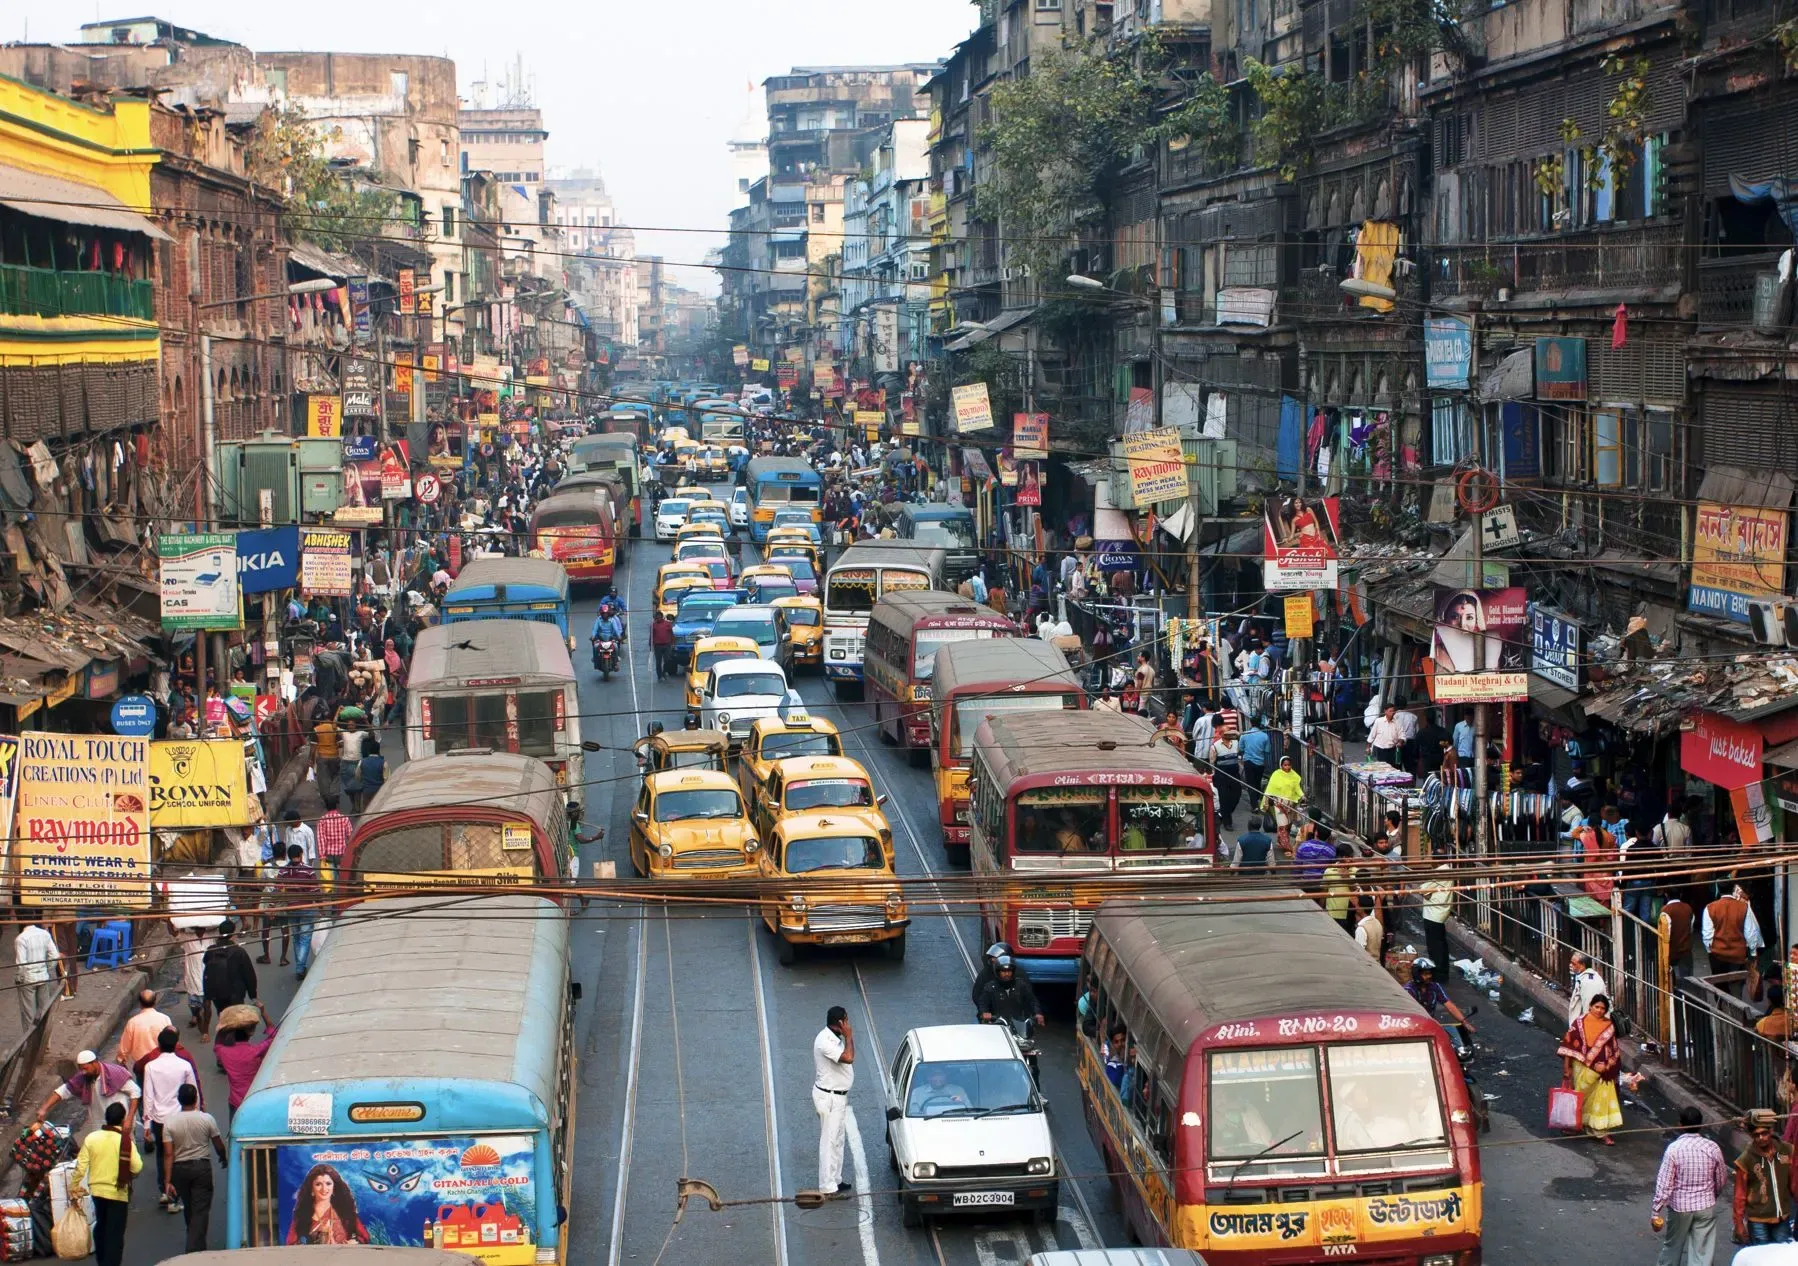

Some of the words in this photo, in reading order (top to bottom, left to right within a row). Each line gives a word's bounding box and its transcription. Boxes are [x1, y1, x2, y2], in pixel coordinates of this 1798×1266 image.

[345, 393, 370, 406] Mala
[1133, 458, 1182, 480] Raymond
[1018, 494, 1039, 502] PRIYA
[305, 534, 350, 547] ABHISHEK
[1100, 554, 1133, 566] CROWN
[1692, 588, 1727, 615] NANDY
[1437, 676, 1468, 687] Madanji
[1470, 674, 1502, 687] Meghraj
[1504, 676, 1511, 684] &
[1513, 675, 1527, 684] Co.
[1551, 670, 1573, 685] STORES
[24, 738, 79, 760] ROYAL
[85, 739, 145, 761] TOUCH
[1709, 732, 1728, 760] just
[1728, 740, 1756, 769] baked
[23, 765, 97, 783] CREATIONS
[100, 767, 118, 786] (P)
[1152, 775, 1174, 784] Bus
[24, 793, 68, 807] LINEN
[28, 815, 140, 853] Raymond
[31, 855, 81, 867] ETHNIC
[85, 856, 122, 868] WEAR
[127, 857, 137, 868] &
[497, 872, 518, 885] Sika
[433, 1180, 493, 1188] GITANJALI
[500, 1177, 528, 1185] GOLD
[1322, 1244, 1356, 1256] TATA
